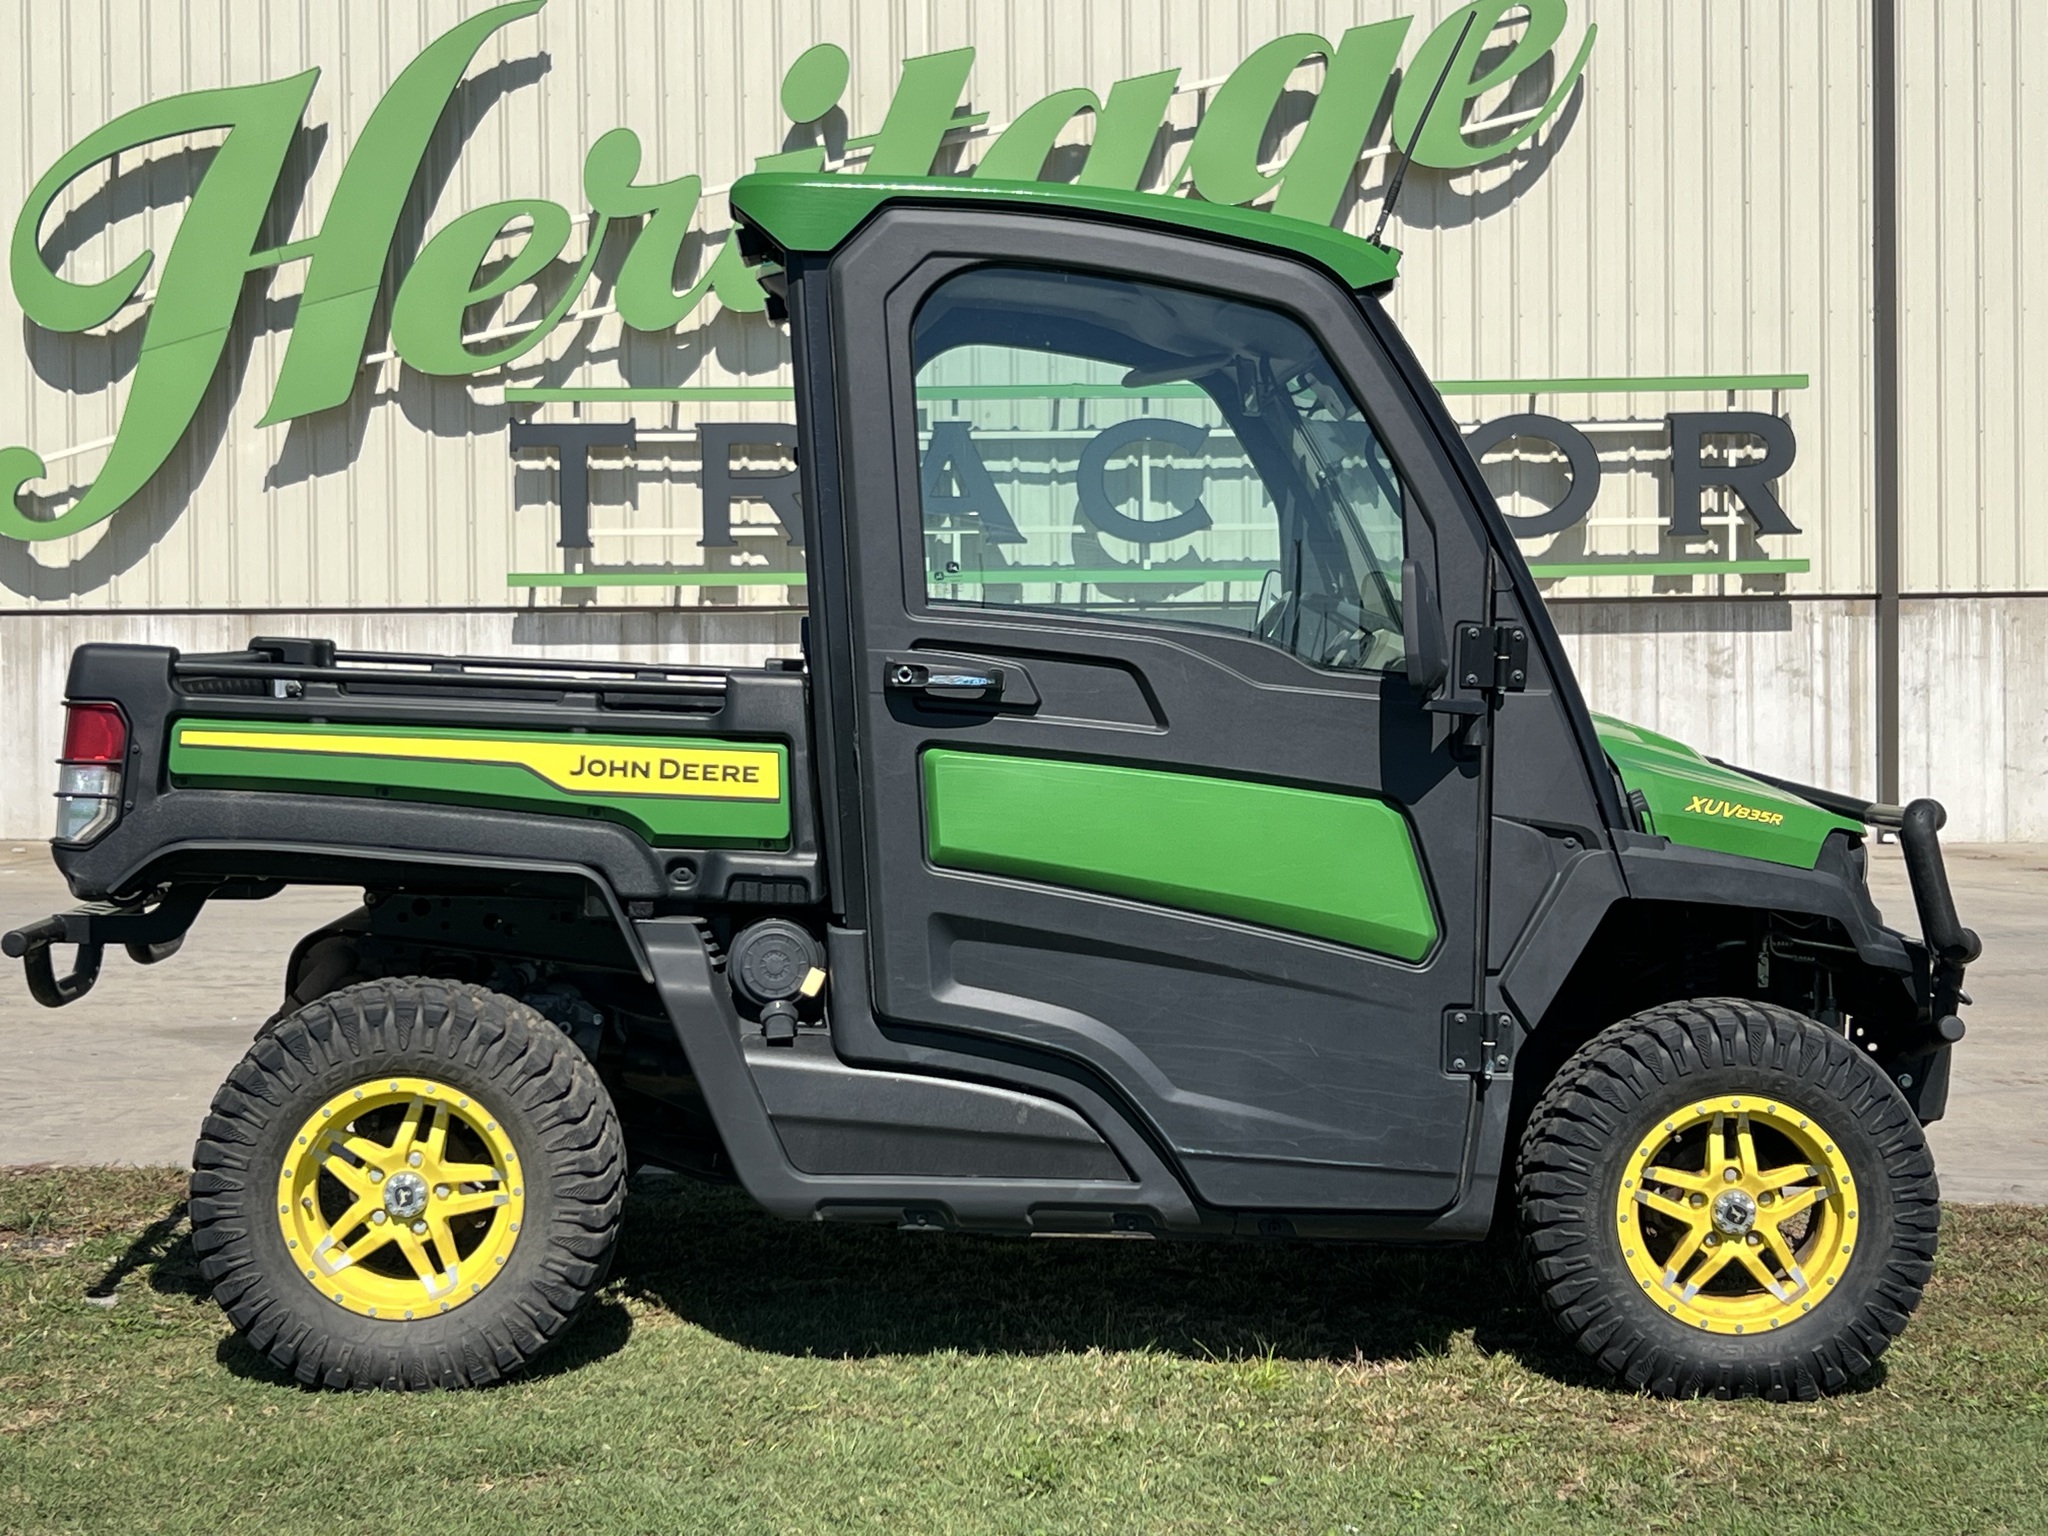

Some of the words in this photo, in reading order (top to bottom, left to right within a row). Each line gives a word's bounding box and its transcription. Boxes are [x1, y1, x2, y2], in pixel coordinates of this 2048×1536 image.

[510, 411, 1802, 548] TRACOR
[569, 755, 650, 779] JOHN
[659, 758, 760, 783] DEERE
[1684, 795, 1784, 826] XUV835R
